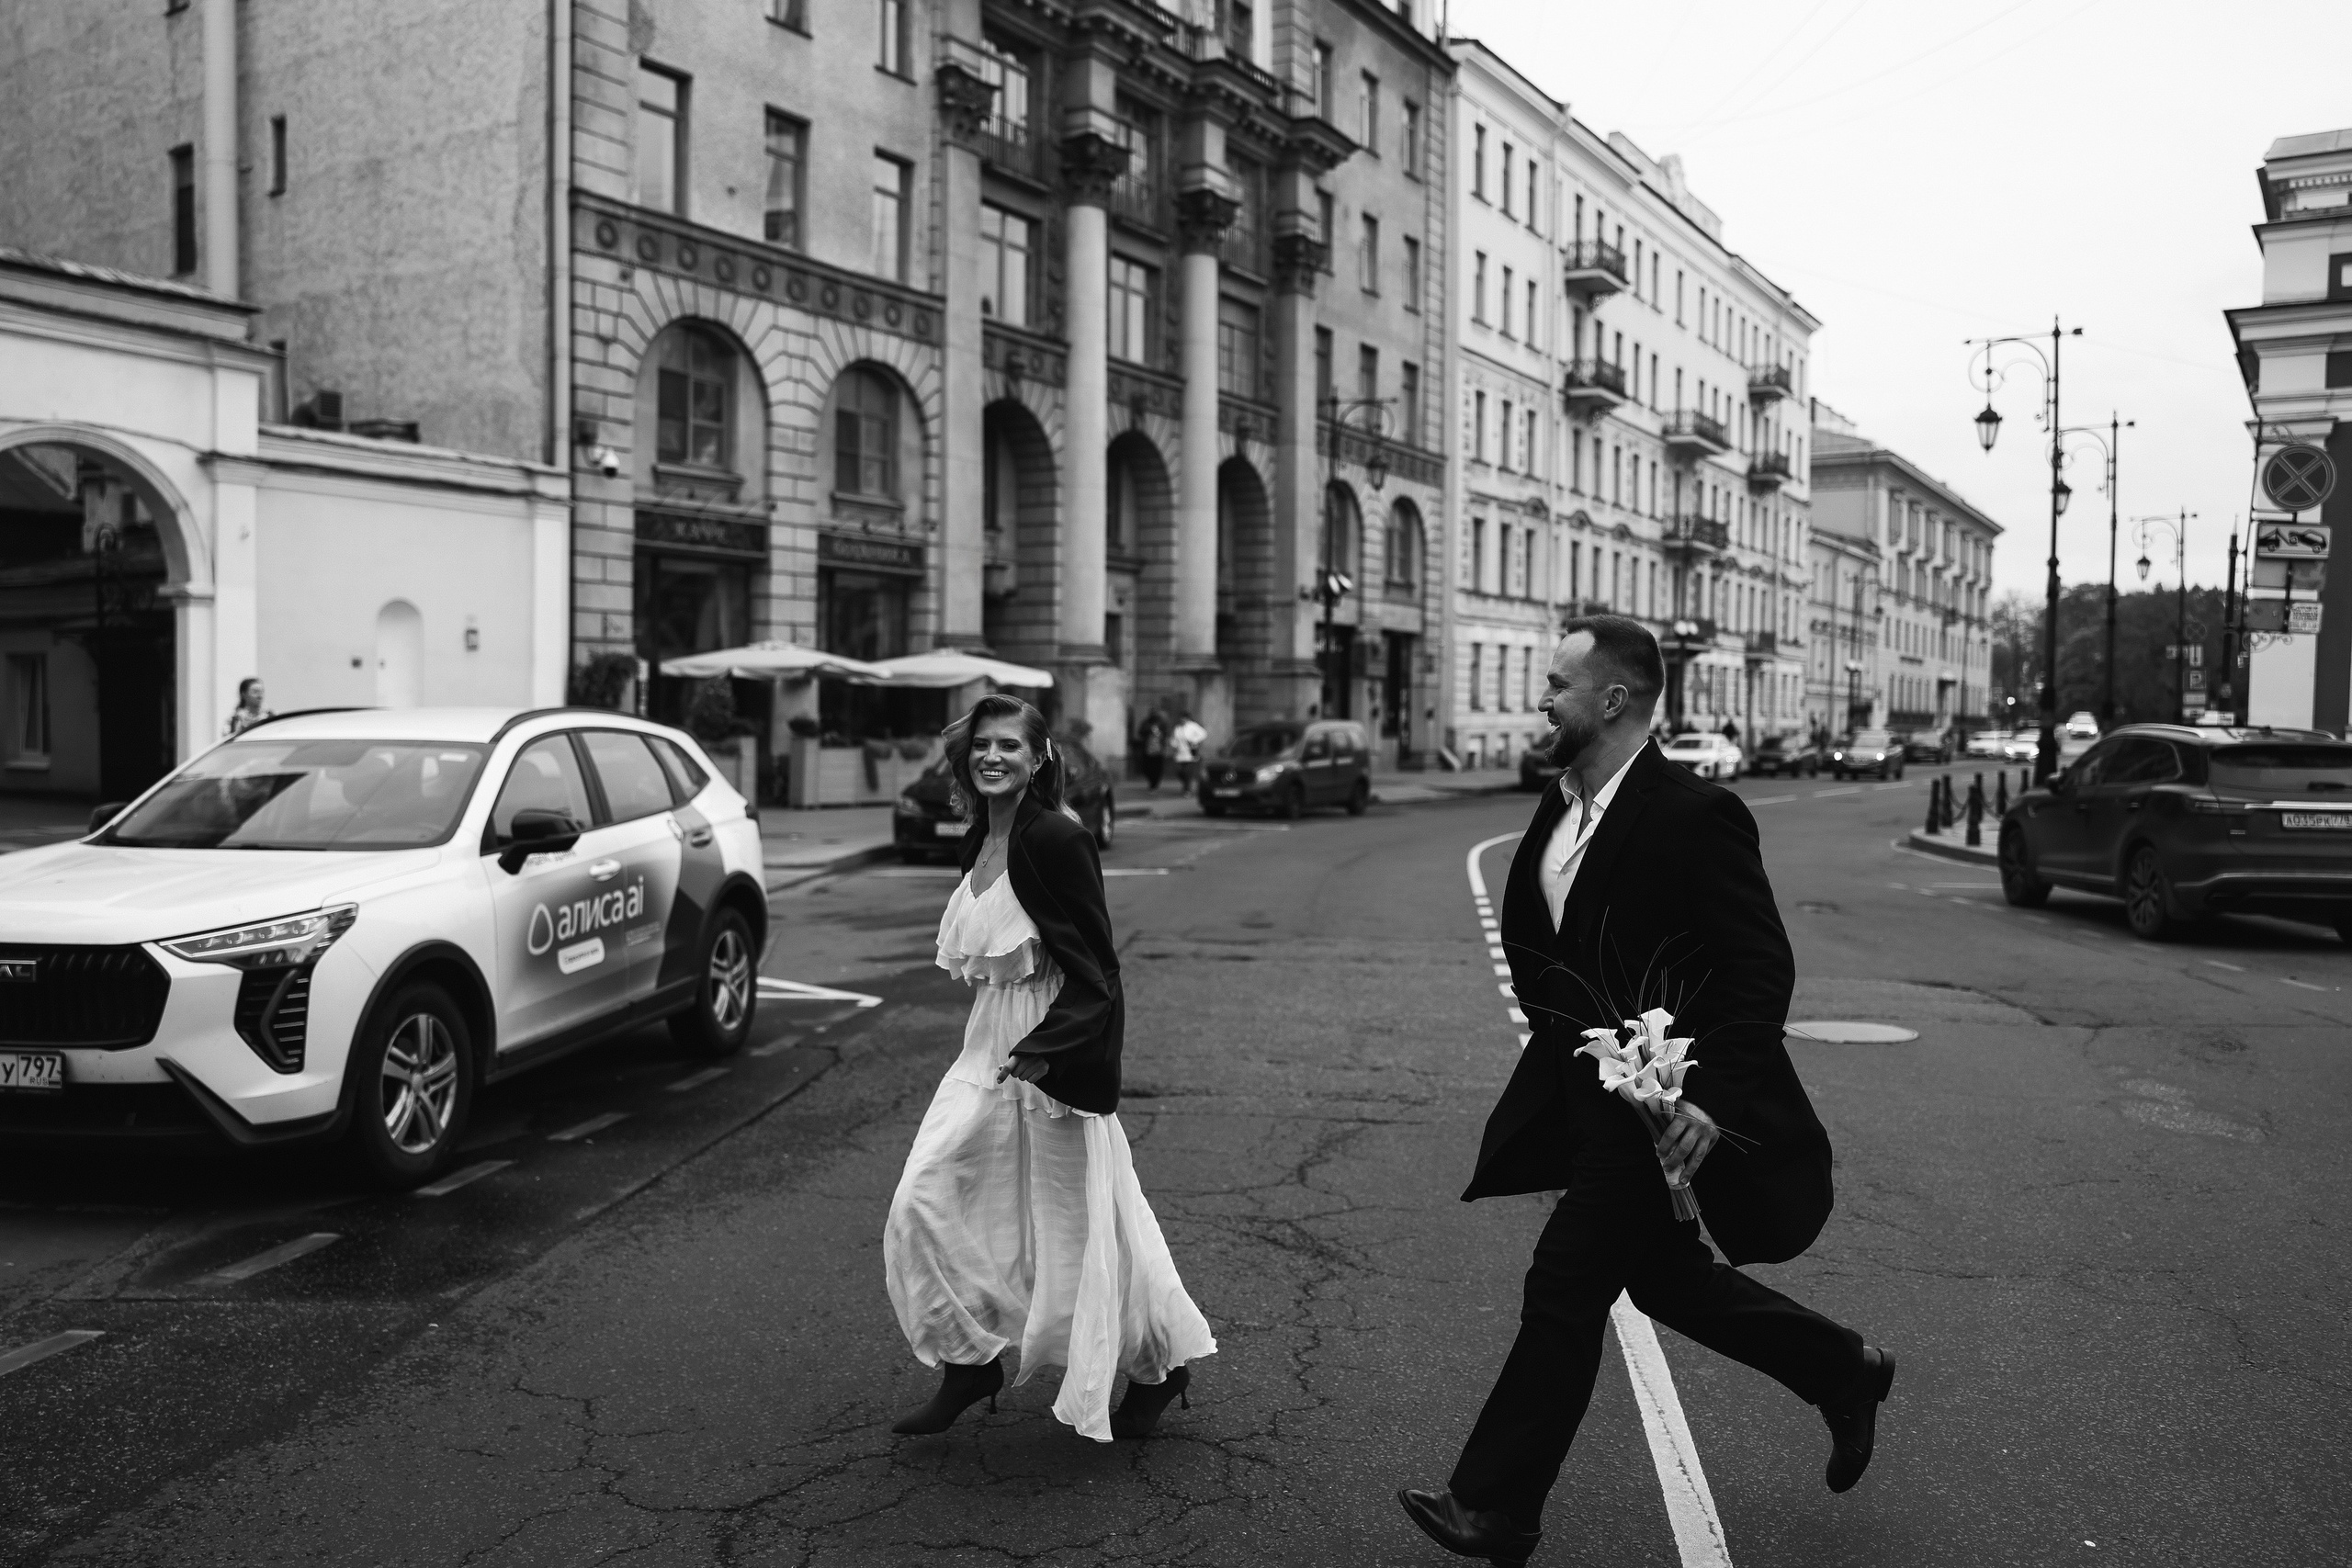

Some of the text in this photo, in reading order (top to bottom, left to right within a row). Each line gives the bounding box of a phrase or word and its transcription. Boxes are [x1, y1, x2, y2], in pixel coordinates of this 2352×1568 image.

[557, 889, 624, 941] алиса
[626, 874, 643, 919] ai
[20, 1056, 57, 1077] 797
[29, 1077, 49, 1086] RUS
